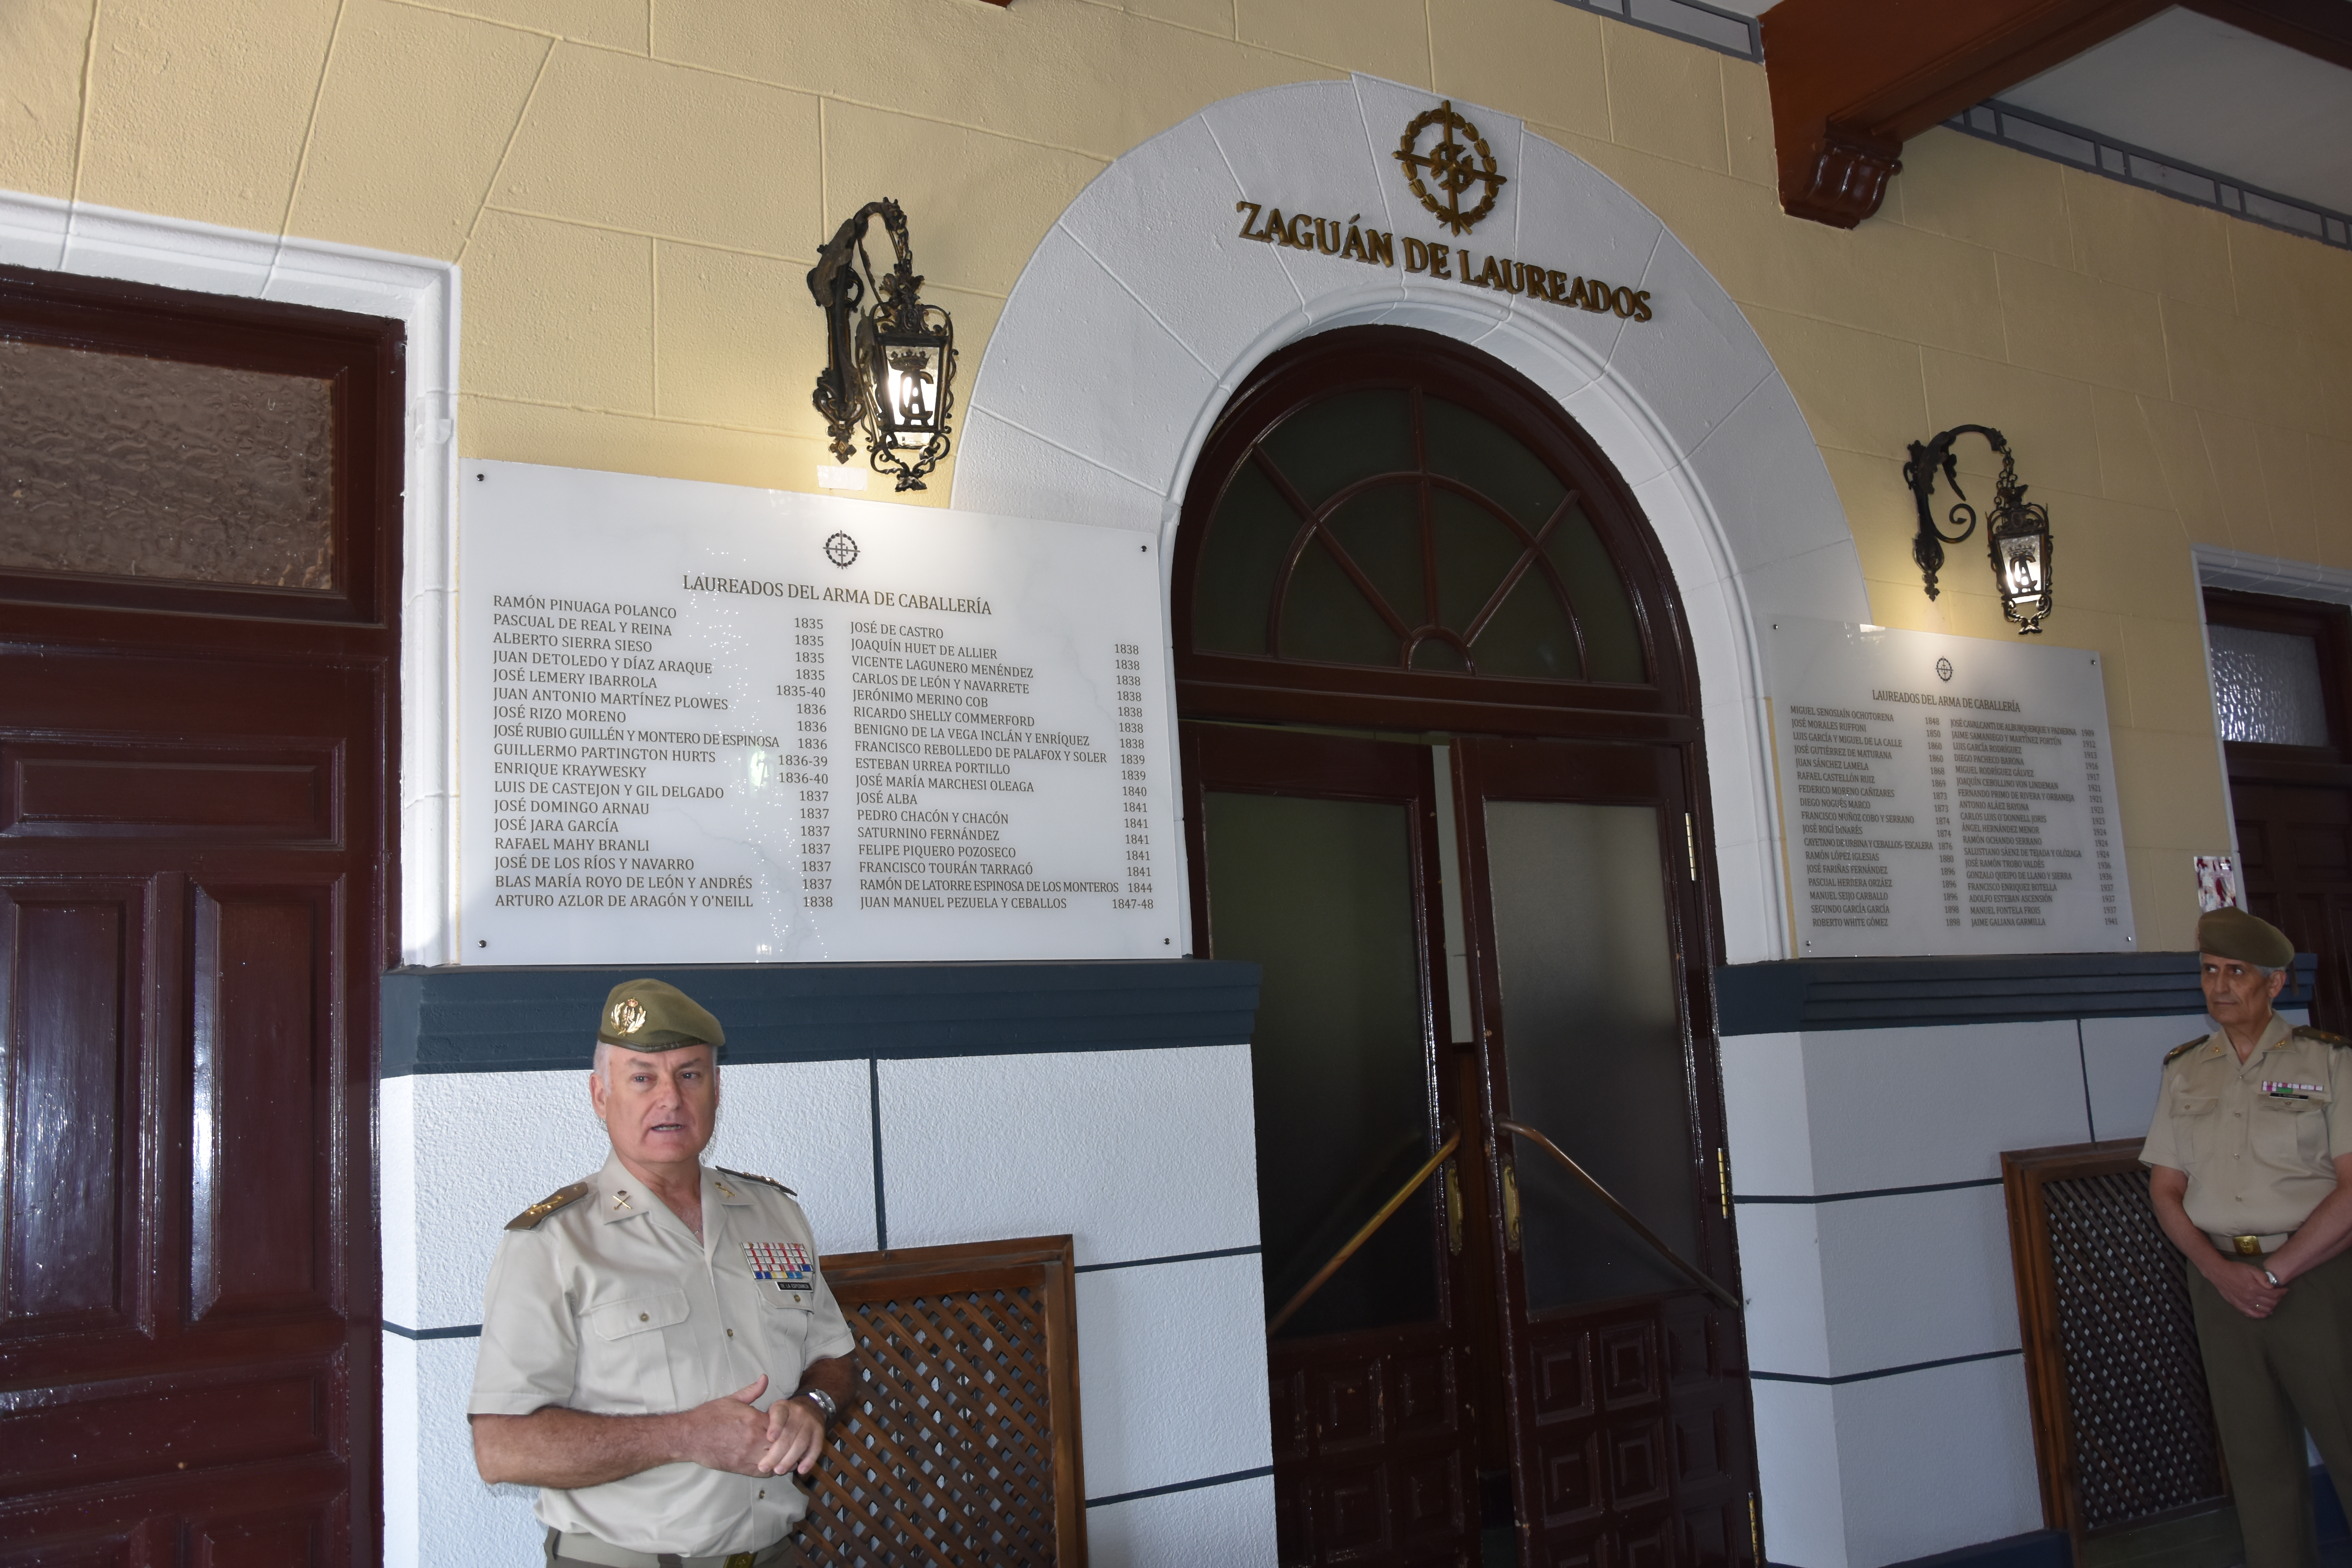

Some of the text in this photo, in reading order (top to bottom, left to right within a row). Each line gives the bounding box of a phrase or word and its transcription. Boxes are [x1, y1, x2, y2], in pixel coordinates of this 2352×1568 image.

[1236, 201, 1653, 323] ZAGUÁN DE LAUREADOS
[683, 574, 992, 615] LAUREADOS DEL ARMA DE CABALLERÍA
[494, 594, 823, 630] RAMÓN PINUAGA POLANCO 1835
[493, 632, 824, 664] ALBERTO SIERRA SIESO 1835
[850, 621, 1139, 655] JOSÉ DE CASTRO 1838
[851, 655, 1141, 686] VICENTE LAGUNERO MENÉNDEZ 1838
[493, 667, 826, 698] JOSÉ LEMERY IBARROLA 1835-40
[853, 688, 1143, 718] JERÓNIMO MERINO COB 1838
[1873, 690, 2020, 713] LAUREADOS DEL ARMA DE CABALLERÍA
[493, 704, 827, 732] JOSÉ RIZO MORENO 1836
[1791, 705, 1940, 725] MIGUEL SENOSIAÍN OCHOTORENA 1848
[494, 743, 828, 767] GUILLERMO PARTINGTON HURTS 1836-39
[1967, 743, 1988, 751] GARCÍA
[1989, 745, 2022, 754] RODRÍGUEZ
[855, 757, 1146, 780] ESTEBAN URREA PORTILLO 1839
[1796, 758, 1945, 775] JUAN SÁNCHEZ LAMELA 1868
[1955, 765, 1978, 774] MIGUEL
[1979, 767, 2012, 776] RODRÍGUEZ
[494, 780, 829, 802] LUIS DE CASTEJON Y GIL DELGADO 1837
[1799, 784, 1830, 794] FEDERICO
[1832, 786, 1859, 795] MORENO
[1861, 787, 1895, 797] CAÑIZARES
[856, 790, 1147, 812] JOSÉ ALBA 1841
[494, 815, 830, 837] JOSÉ JARA GARCÍA 1837
[1801, 811, 1837, 820] FRANCISCO
[1838, 812, 1861, 821] MUÑOZ
[1862, 814, 1879, 822] COBO
[1886, 815, 1914, 824] SERRANO
[1962, 822, 1981, 831] ÁNGEL
[858, 826, 1149, 845] SATURNINO FERNÁNDEZ 1841
[494, 853, 831, 872] JOSÉ DE LOS RÍOS Y NAVARRO 1837
[859, 860, 1151, 877] FRANCISCO TOURÁN TARRAGÓ 1841
[1807, 863, 1822, 874] JOSÉ
[1823, 864, 1849, 873] FARIÑAS
[1851, 864, 1888, 874] FERNÁNDEZ
[1838, 892, 1855, 901] SEIJO
[1856, 892, 1888, 900] CARBALLO
[2002, 884, 2030, 892] ENRIQUEZ
[495, 892, 833, 907] ARTURO AZLOR DE ARAGÓN Y O'NEILL 1838
[860, 897, 1154, 910] JUAN MANUEL PEZUELA Y CEBALLOS 1847-48
[1813, 918, 1842, 927] ROBERTO
[1867, 917, 1888, 926] GÓMEZ
[1946, 918, 1960, 926] 1898
